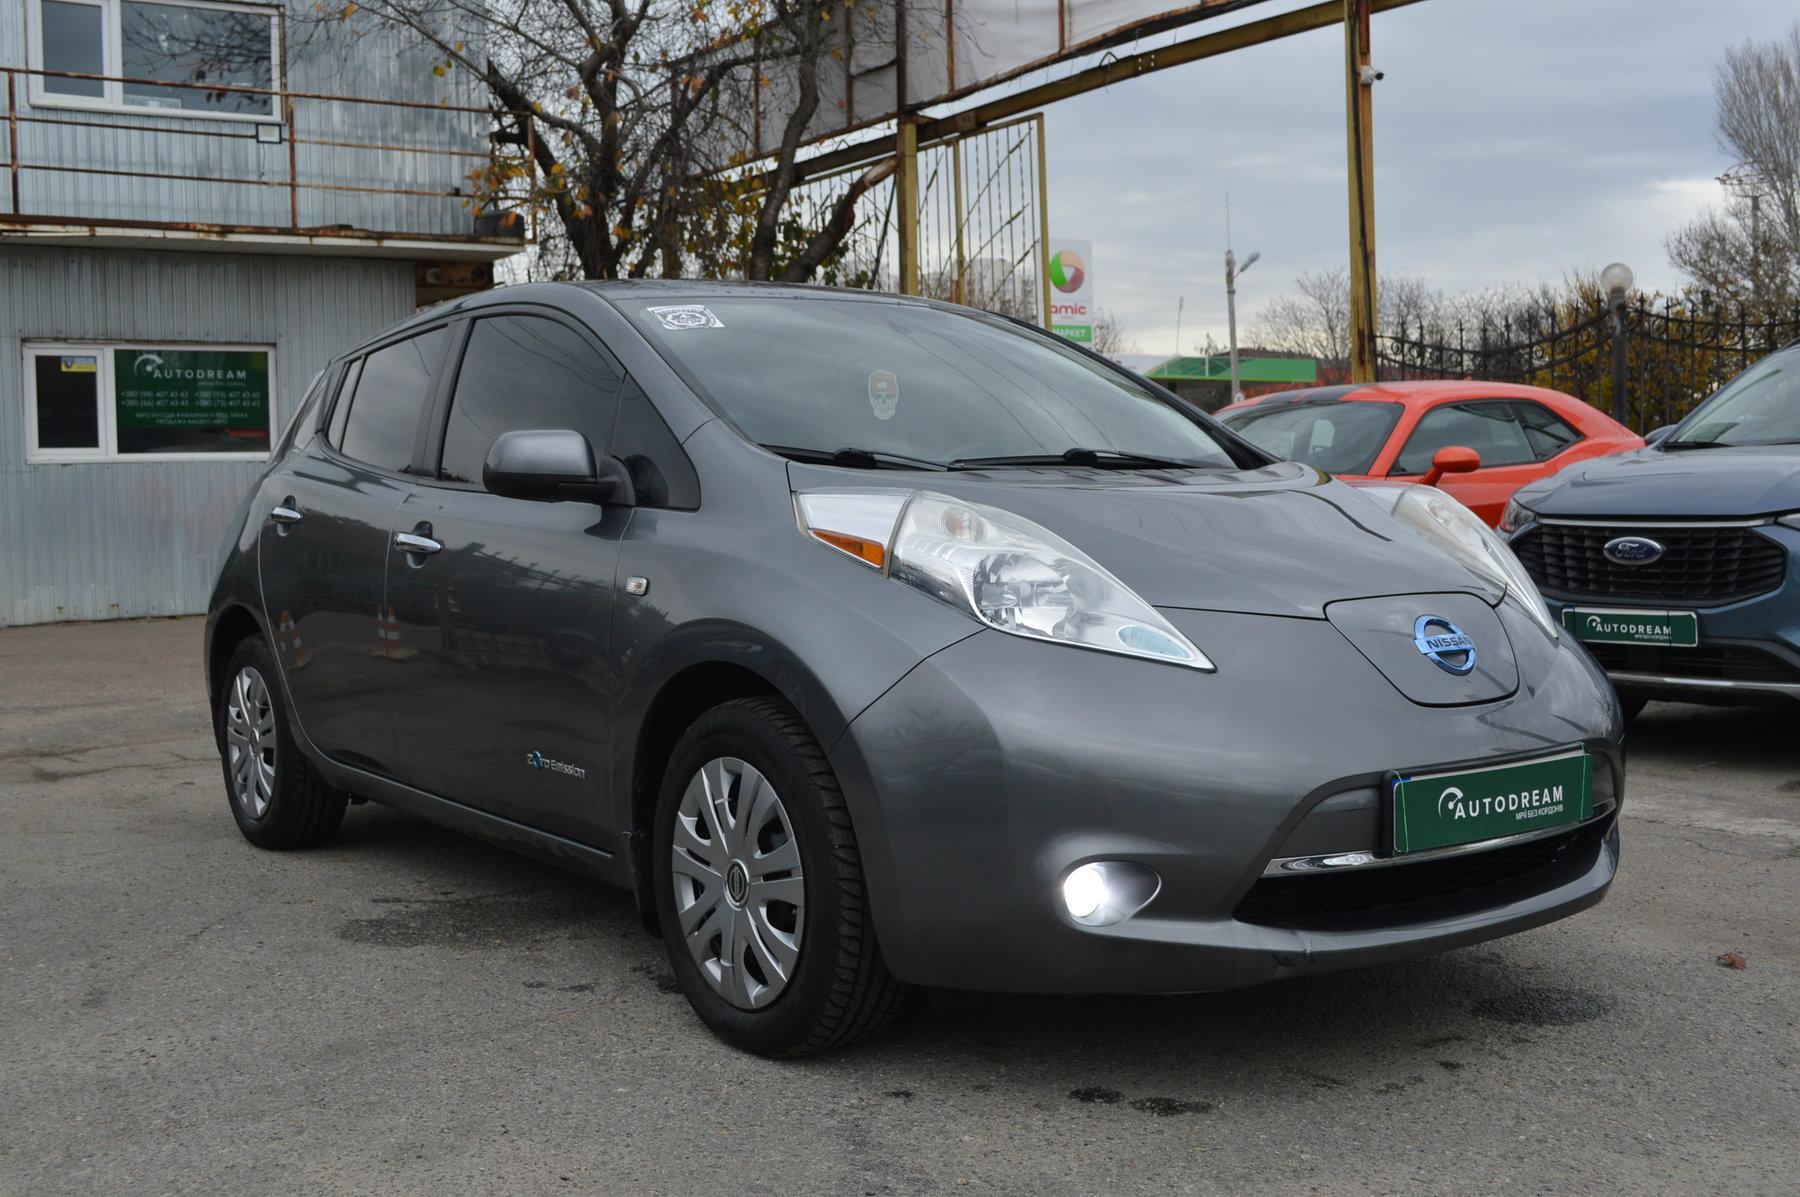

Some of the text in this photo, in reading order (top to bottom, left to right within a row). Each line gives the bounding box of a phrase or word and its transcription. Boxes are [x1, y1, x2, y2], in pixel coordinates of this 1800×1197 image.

[1049, 302, 1087, 315] amic
[153, 369, 247, 379] AUTODREAM
[120, 390, 139, 398] +380
[155, 390, 169, 398] 407
[120, 399, 139, 407] +380
[155, 399, 169, 407] 407
[1615, 542, 1648, 558] Ford
[1596, 623, 1672, 635] AUTODREAM
[1426, 636, 1473, 649] NISSAN
[550, 759, 585, 779] Emission
[1454, 785, 1563, 819] AUTODREAM
[1515, 804, 1563, 820] МРІЇ БЕЗ КОРДОНІВ
